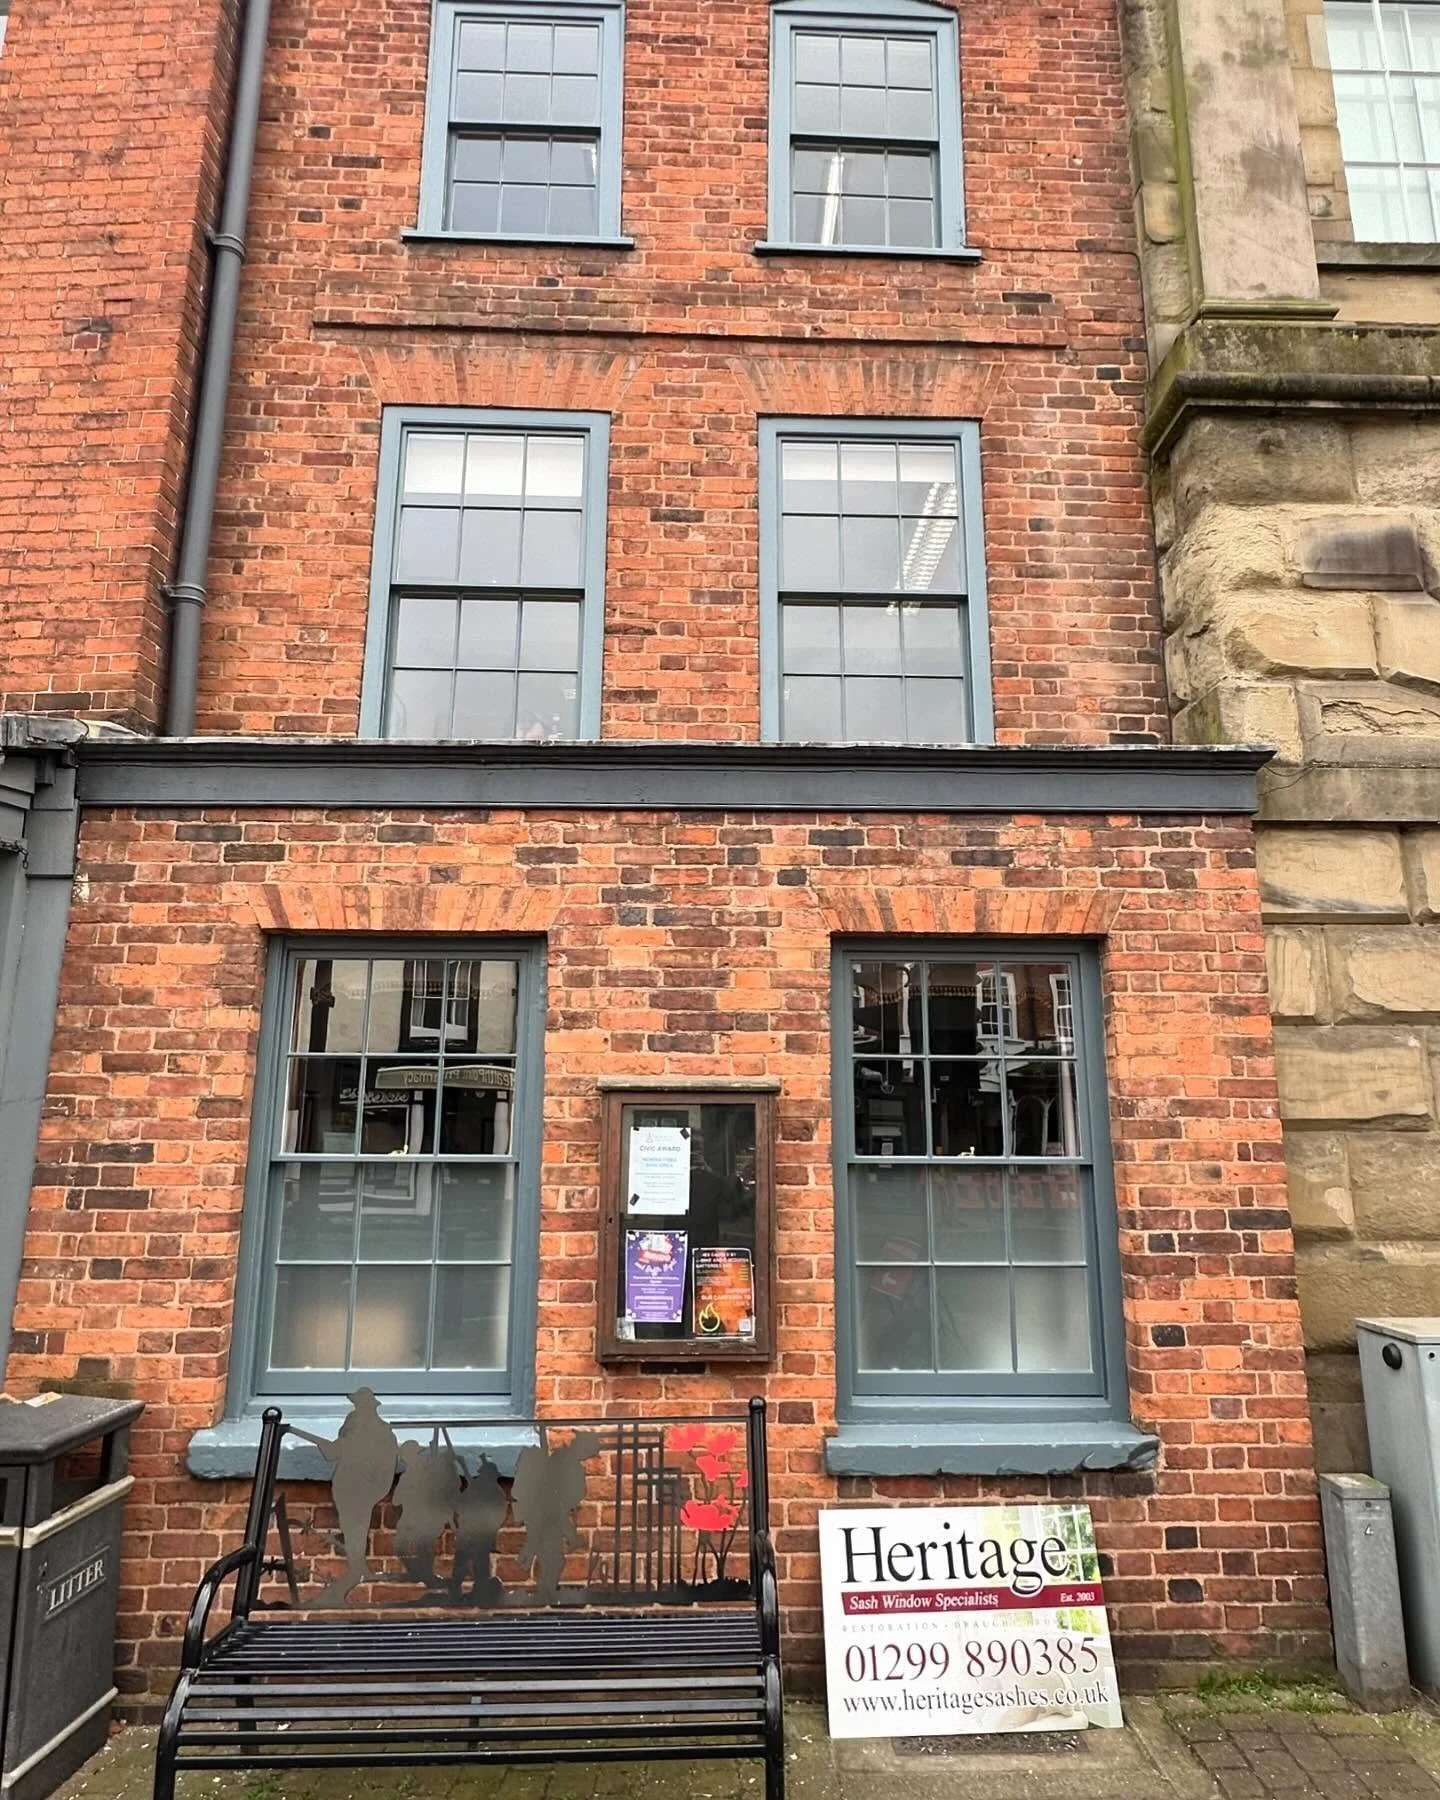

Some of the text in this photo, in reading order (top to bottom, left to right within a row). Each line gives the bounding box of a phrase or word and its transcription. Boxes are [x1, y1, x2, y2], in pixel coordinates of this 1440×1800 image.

[838, 1521, 1069, 1595] Heritage
[49, 1559, 105, 1611] LITTER
[850, 1591, 1095, 1610] Sash Window Specialists Est. 2003
[844, 1636, 1099, 1682] 01299 890385
[843, 1682, 1109, 1715] www.heritagesashes.co.uk
